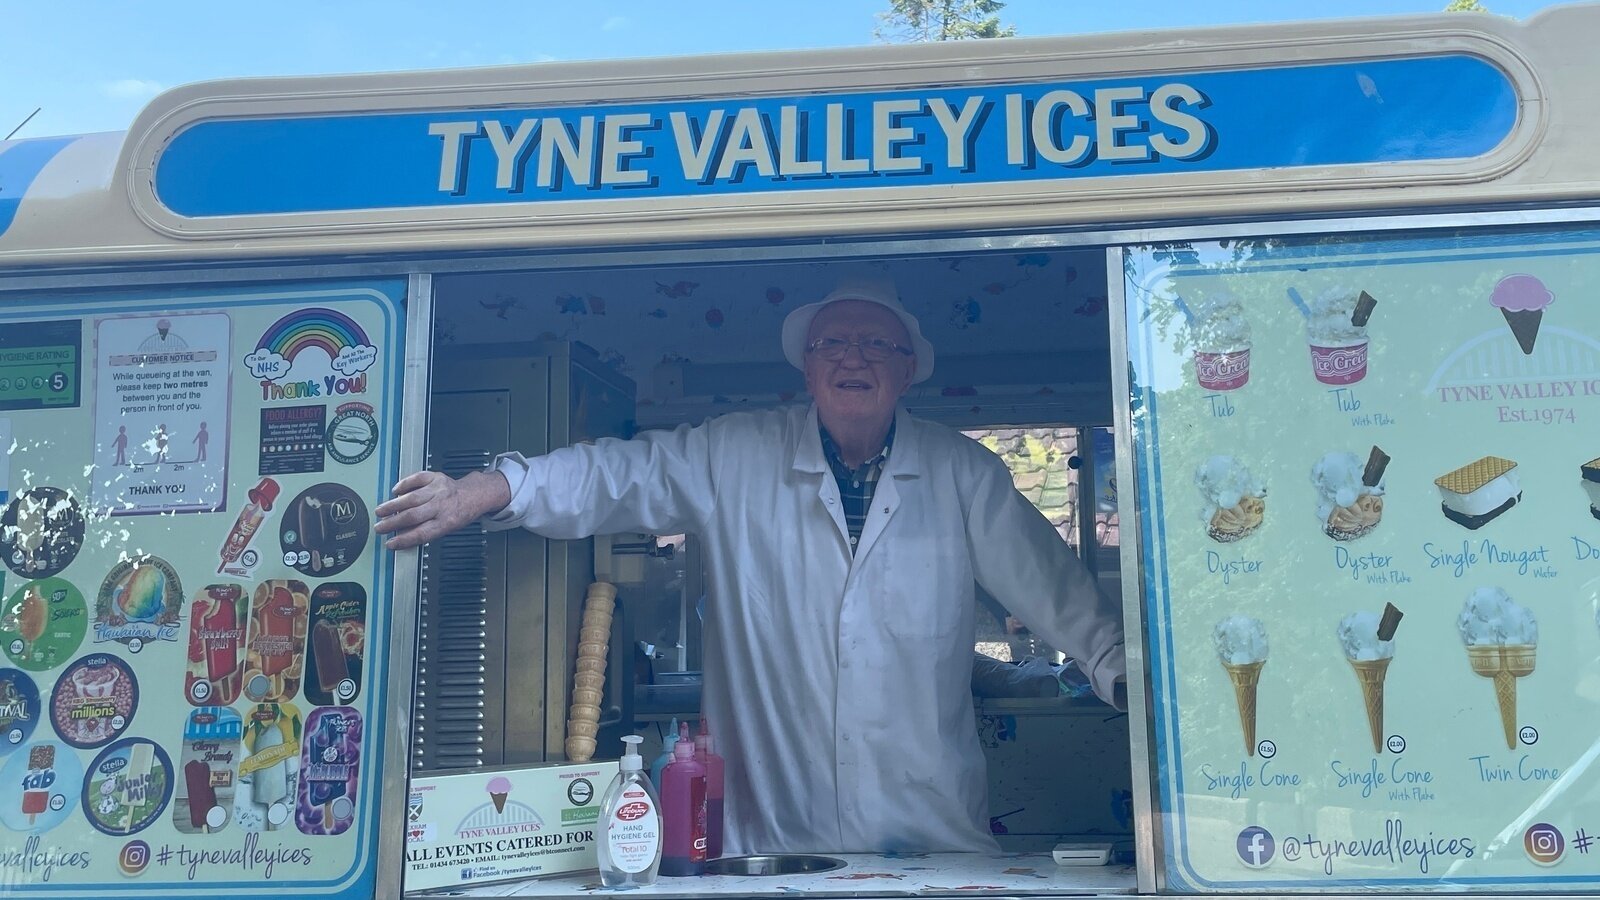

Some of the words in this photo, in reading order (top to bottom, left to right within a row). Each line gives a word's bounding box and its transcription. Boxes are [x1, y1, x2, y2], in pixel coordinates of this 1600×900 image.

[428, 112, 655, 193] TYNE
[669, 94, 988, 183] VALLEY
[1005, 82, 1213, 166] ICES
[0, 351, 35, 361] YGIENE
[36, 350, 70, 360] RATING
[131, 355, 168, 364] CUSTOMER
[169, 353, 195, 363] NOTICE
[336, 360, 347, 369] Key
[349, 353, 373, 364] Workers
[257, 361, 280, 373] NHS
[1314, 356, 1331, 372] Ice
[53, 374, 64, 390] 5
[112, 372, 134, 381] While
[135, 370, 171, 381] queueing
[172, 370, 180, 378] at
[182, 369, 194, 377] the
[196, 369, 212, 377] van,
[116, 383, 141, 392] please
[143, 382, 162, 391] keep
[163, 381, 178, 389] two
[180, 380, 208, 388] metres
[260, 379, 321, 400] Thank
[323, 373, 367, 396] You!
[1436, 384, 1493, 402] TYNE
[1497, 380, 1577, 400] VALLEY
[122, 393, 155, 402] between
[156, 394, 171, 403] you
[172, 391, 187, 400] and
[188, 391, 201, 399] the
[1328, 388, 1361, 412] Tub
[120, 405, 146, 414] person
[148, 403, 156, 412] in
[157, 403, 175, 412] front
[176, 402, 185, 410] of
[185, 403, 202, 412] you.
[1202, 394, 1235, 417] Tub
[334, 410, 355, 424] GREAT
[355, 411, 375, 427] NORTH
[1351, 414, 1371, 427] With
[1496, 406, 1577, 425] Est.1974
[173, 464, 185, 472] 2m
[128, 485, 162, 496] THANK
[164, 484, 186, 494] YOU
[335, 503, 352, 518] M
[335, 531, 357, 541] CLASSIC
[1333, 546, 1393, 581] Oyster
[1423, 539, 1478, 578] Single
[1480, 538, 1551, 576] Nougat
[1206, 550, 1264, 585] Oyster
[1533, 565, 1558, 578] Wafer
[1366, 573, 1388, 584] With
[96, 622, 154, 640] Hawaiian
[157, 624, 177, 640] Ice
[198, 626, 243, 640] Strawberry
[87, 656, 107, 666] stella
[71, 705, 115, 719] millions
[191, 741, 220, 753] Cherry
[1260, 745, 1274, 753] £1.50
[102, 758, 125, 771] stella
[201, 750, 234, 764] Brandy
[1468, 755, 1512, 782] Twin
[1518, 754, 1561, 782] Cone
[21, 769, 57, 791] fab
[1201, 761, 1255, 800] Single
[1260, 760, 1301, 787] Cone
[1331, 758, 1387, 798] Single
[1391, 757, 1434, 784] Cone
[1388, 788, 1410, 801] With
[1412, 786, 1435, 802] Flake
[619, 805, 648, 816] Lifebuoy
[459, 829, 485, 840] TYNE
[486, 826, 522, 836] VALLEY
[521, 823, 541, 832] ICES
[611, 832, 641, 840] HYGIENE
[643, 831, 656, 839] GEL
[406, 848, 433, 862] ALL
[435, 841, 493, 860] EVENTS
[496, 833, 563, 853] CATERED
[566, 830, 594, 844] FOR
[621, 845, 639, 854] Total
[639, 845, 648, 853] 10
[1283, 818, 1476, 876] @tynevalleyices
[0, 836, 91, 882] valleyices
[156, 833, 312, 880] #tynevalleyices
[412, 863, 429, 871] TEL:
[429, 861, 448, 869] 01434
[448, 858, 470, 866] 673420
[475, 855, 500, 863] EMAIL:
[501, 845, 586, 860] tynevalleyices@btconnect.com
[473, 869, 500, 878] Facebook
